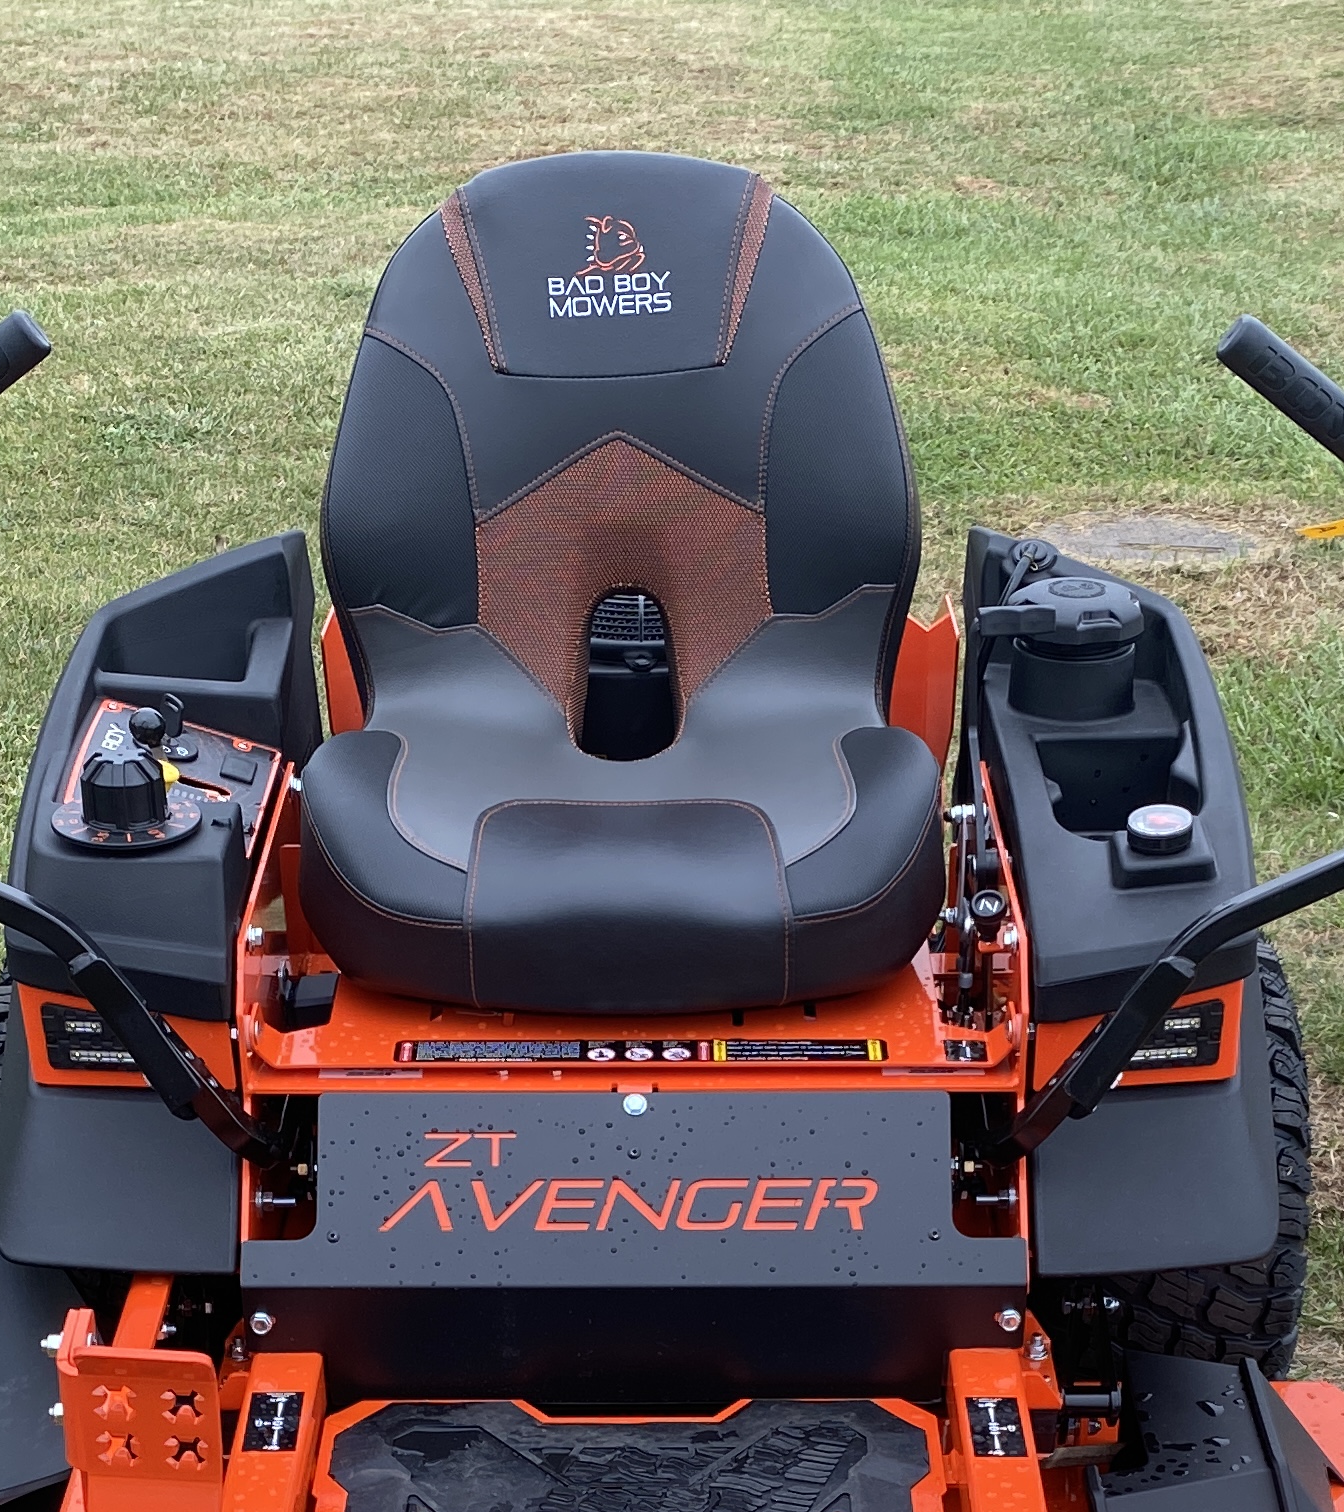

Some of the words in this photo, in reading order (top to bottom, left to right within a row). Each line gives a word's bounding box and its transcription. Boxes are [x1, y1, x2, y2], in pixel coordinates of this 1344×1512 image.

[548, 275, 604, 295] BAD
[614, 271, 671, 293] BOY
[549, 292, 671, 318] MOWERS
[423, 1131, 517, 1168] ZT
[378, 1178, 879, 1232] AVENGER
